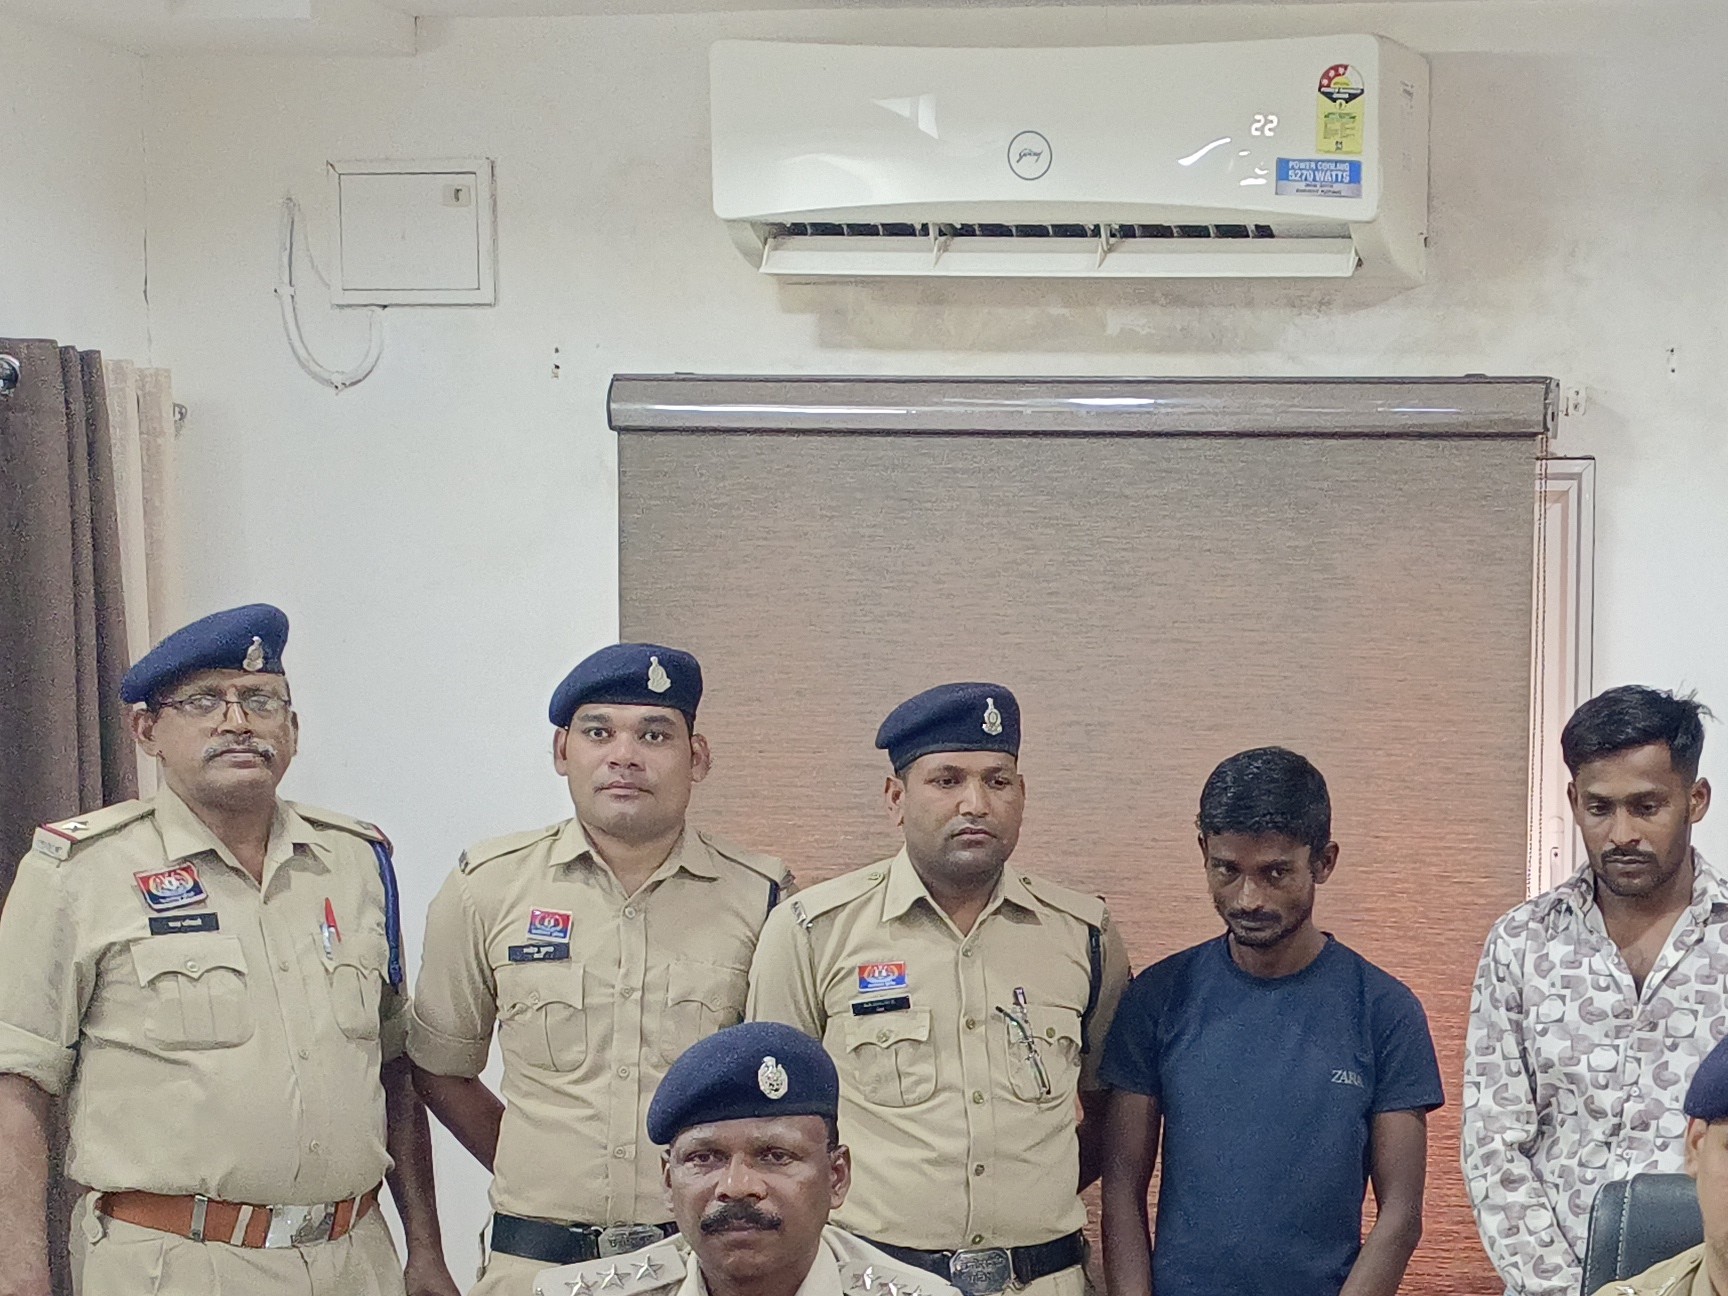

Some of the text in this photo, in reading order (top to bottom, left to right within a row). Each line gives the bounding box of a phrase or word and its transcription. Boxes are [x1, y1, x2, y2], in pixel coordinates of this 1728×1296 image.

[1251, 114, 1278, 137] 22
[1288, 169, 1350, 183] 5270 WATTS
